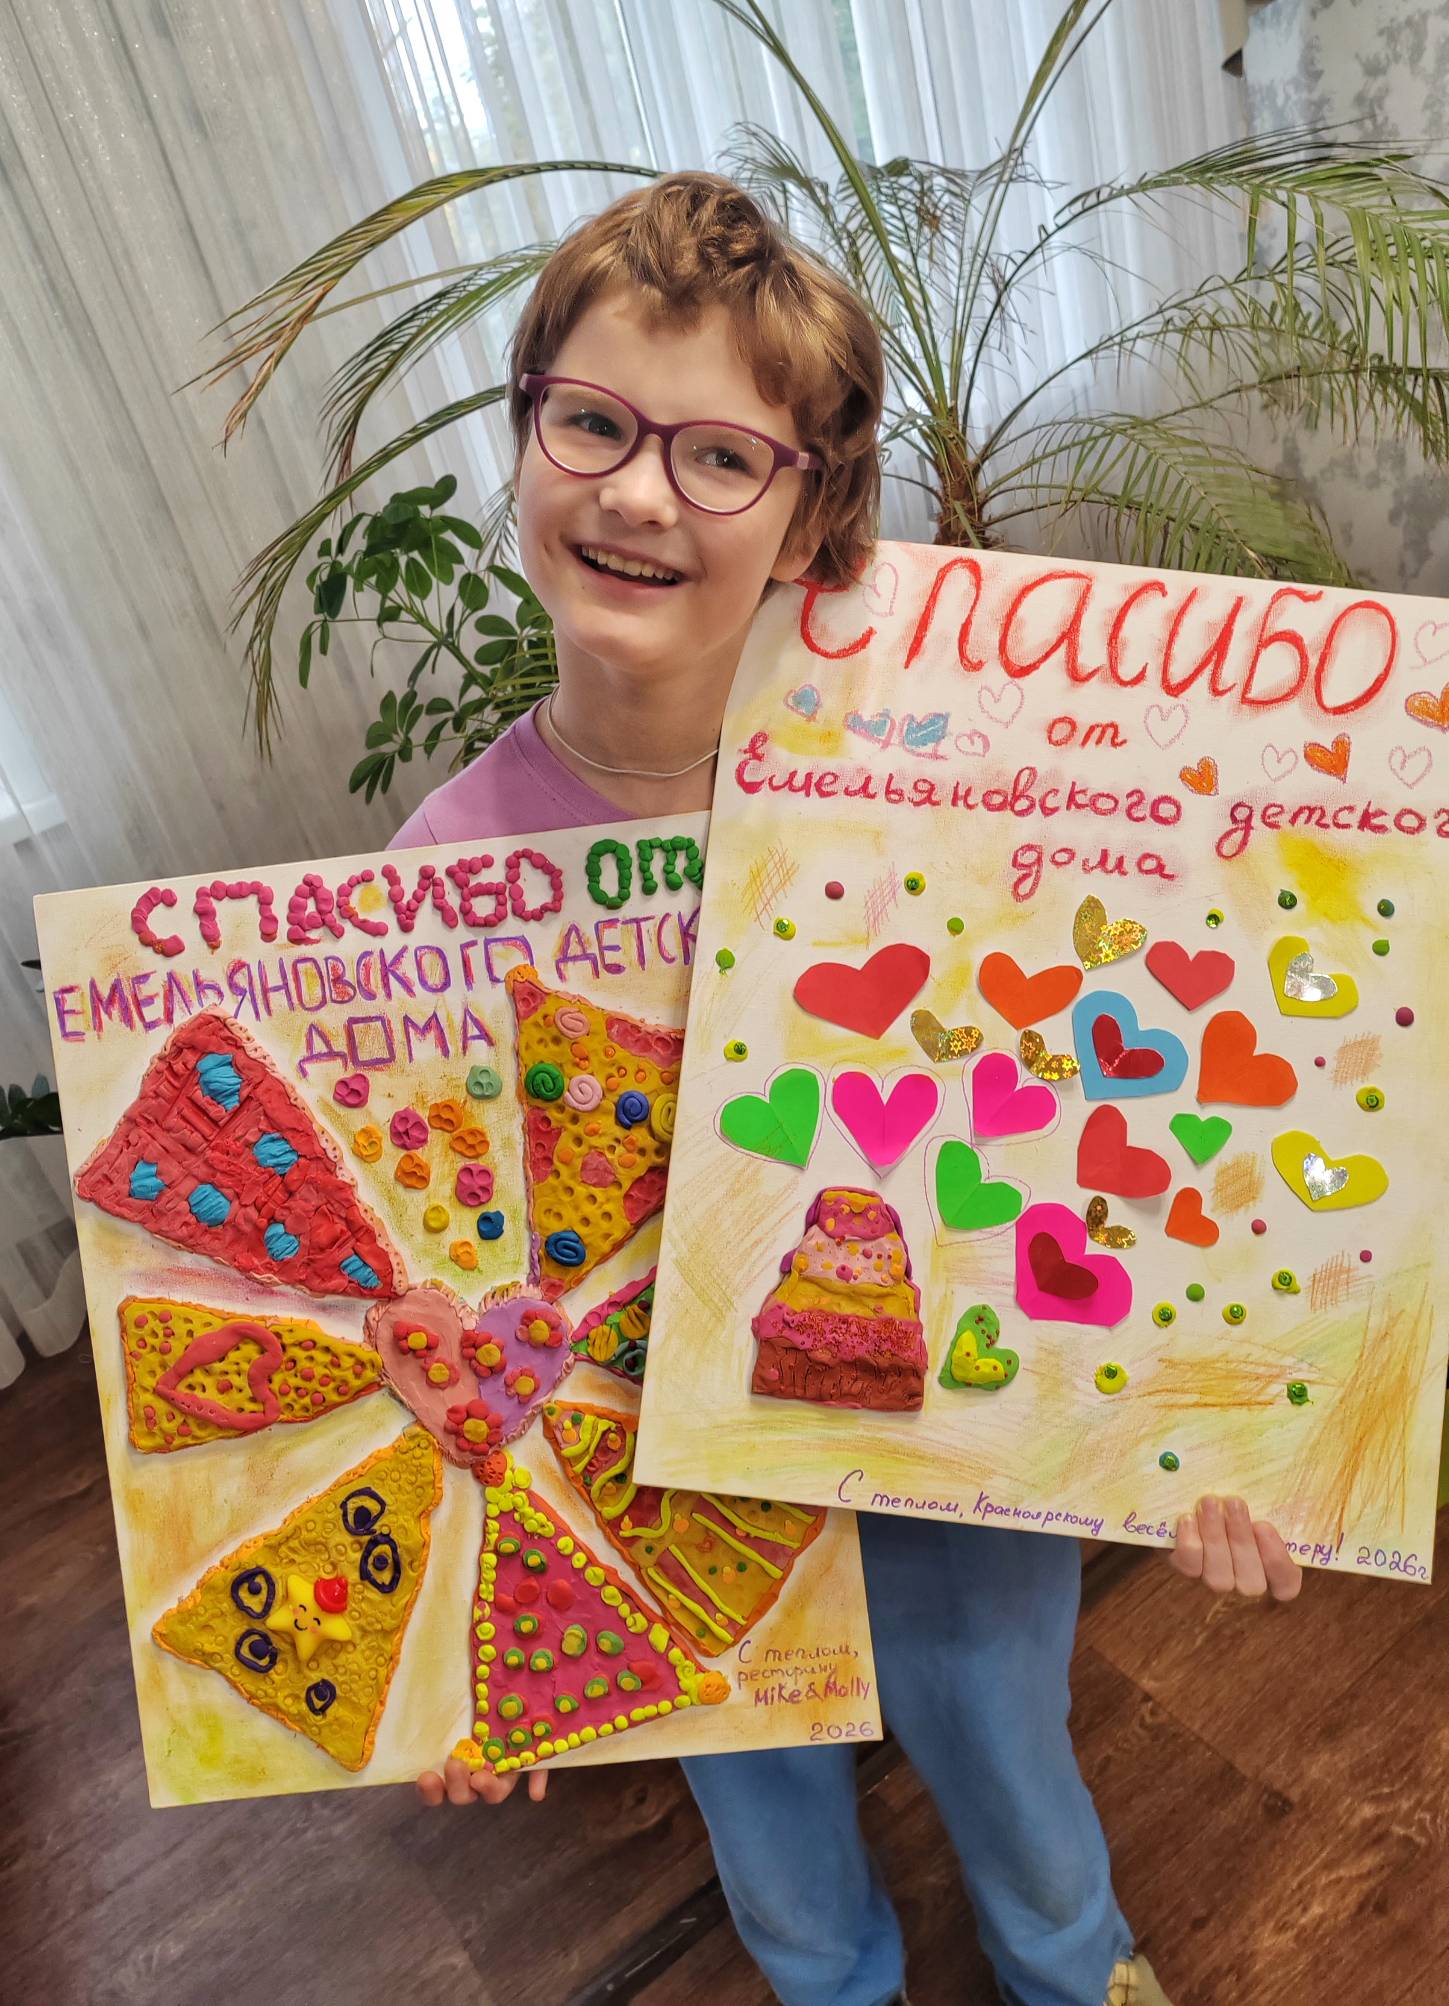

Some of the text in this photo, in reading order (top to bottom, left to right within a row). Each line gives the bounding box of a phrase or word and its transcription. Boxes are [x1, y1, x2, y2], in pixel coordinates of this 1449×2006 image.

[1046, 715, 1128, 750] от
[734, 731, 1183, 827] Емельяновского
[131, 848, 566, 958] СПАСИБО
[1010, 842, 1175, 903] дома
[52, 934, 535, 1042] ЕМЕЛЬЯНОВСКОГО
[297, 1004, 497, 1080] ДОМА
[837, 1469, 865, 1503] С
[870, 1491, 964, 1519] теплом,
[972, 1491, 1105, 1536] Красноярскому
[738, 1640, 752, 1663] С
[810, 1722, 874, 1741] 2026
